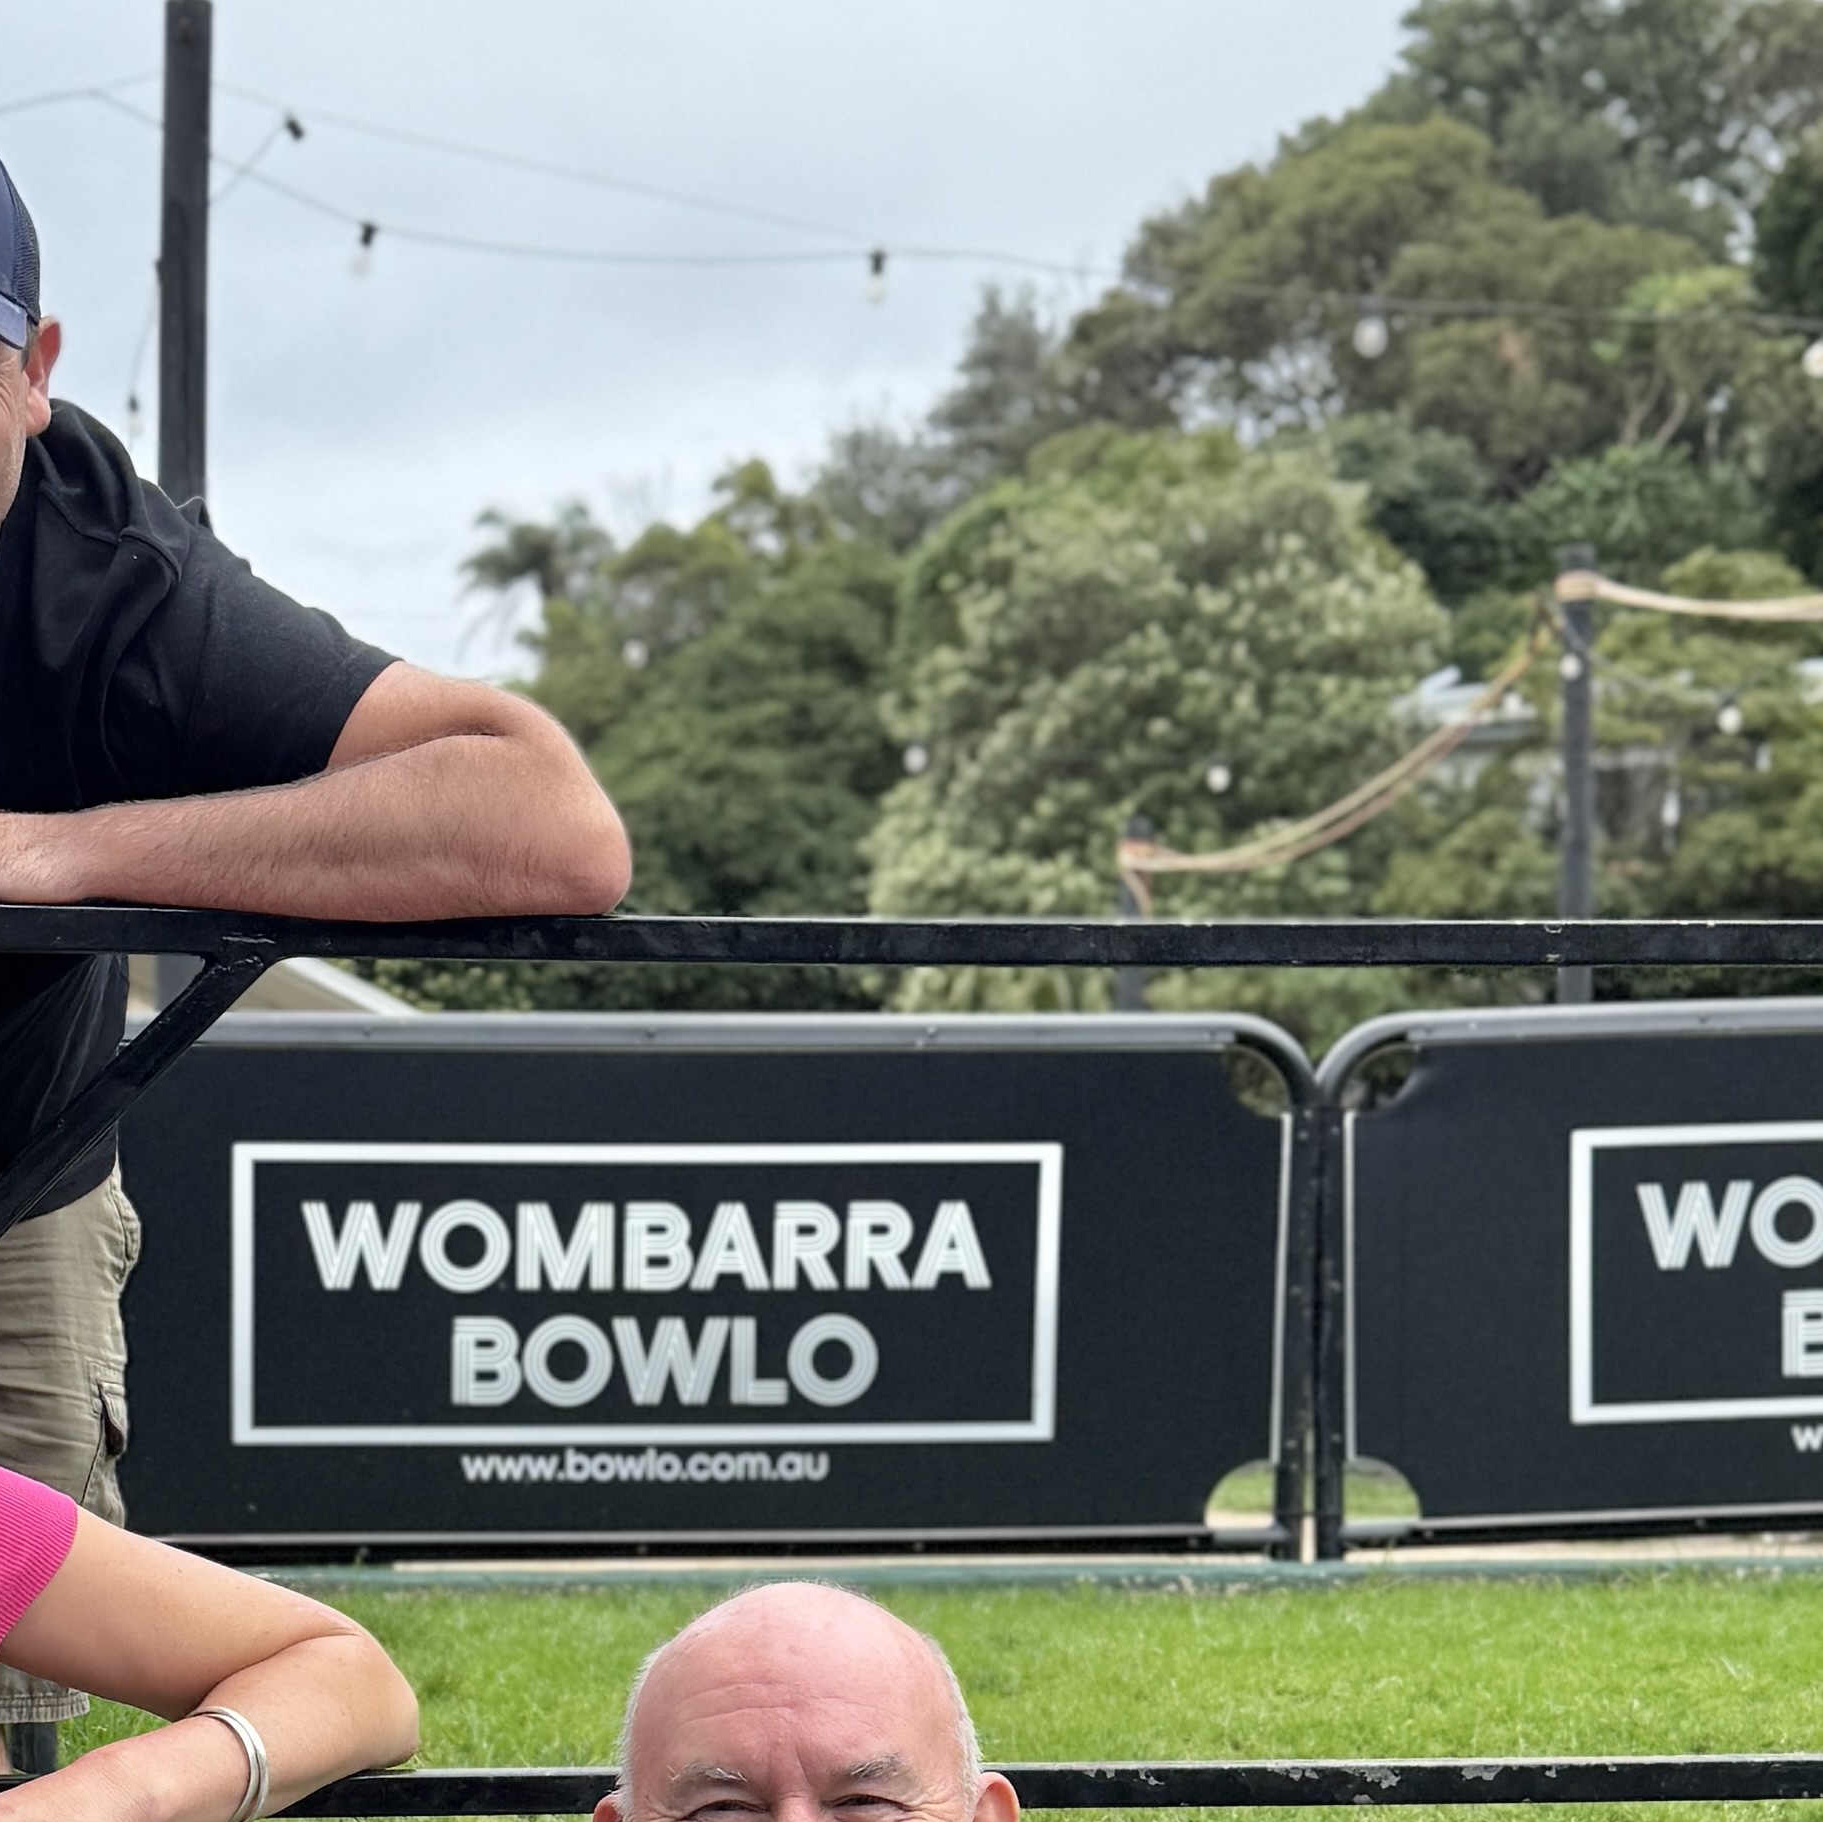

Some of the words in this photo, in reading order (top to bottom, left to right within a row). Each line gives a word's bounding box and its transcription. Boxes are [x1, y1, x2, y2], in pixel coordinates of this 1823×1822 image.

[302, 1199, 992, 1293] WOMBARRA
[1636, 1175, 1823, 1271] WO
[450, 1313, 880, 1407] BOWLO
[461, 1447, 830, 1483] www.bowlo.com.au
